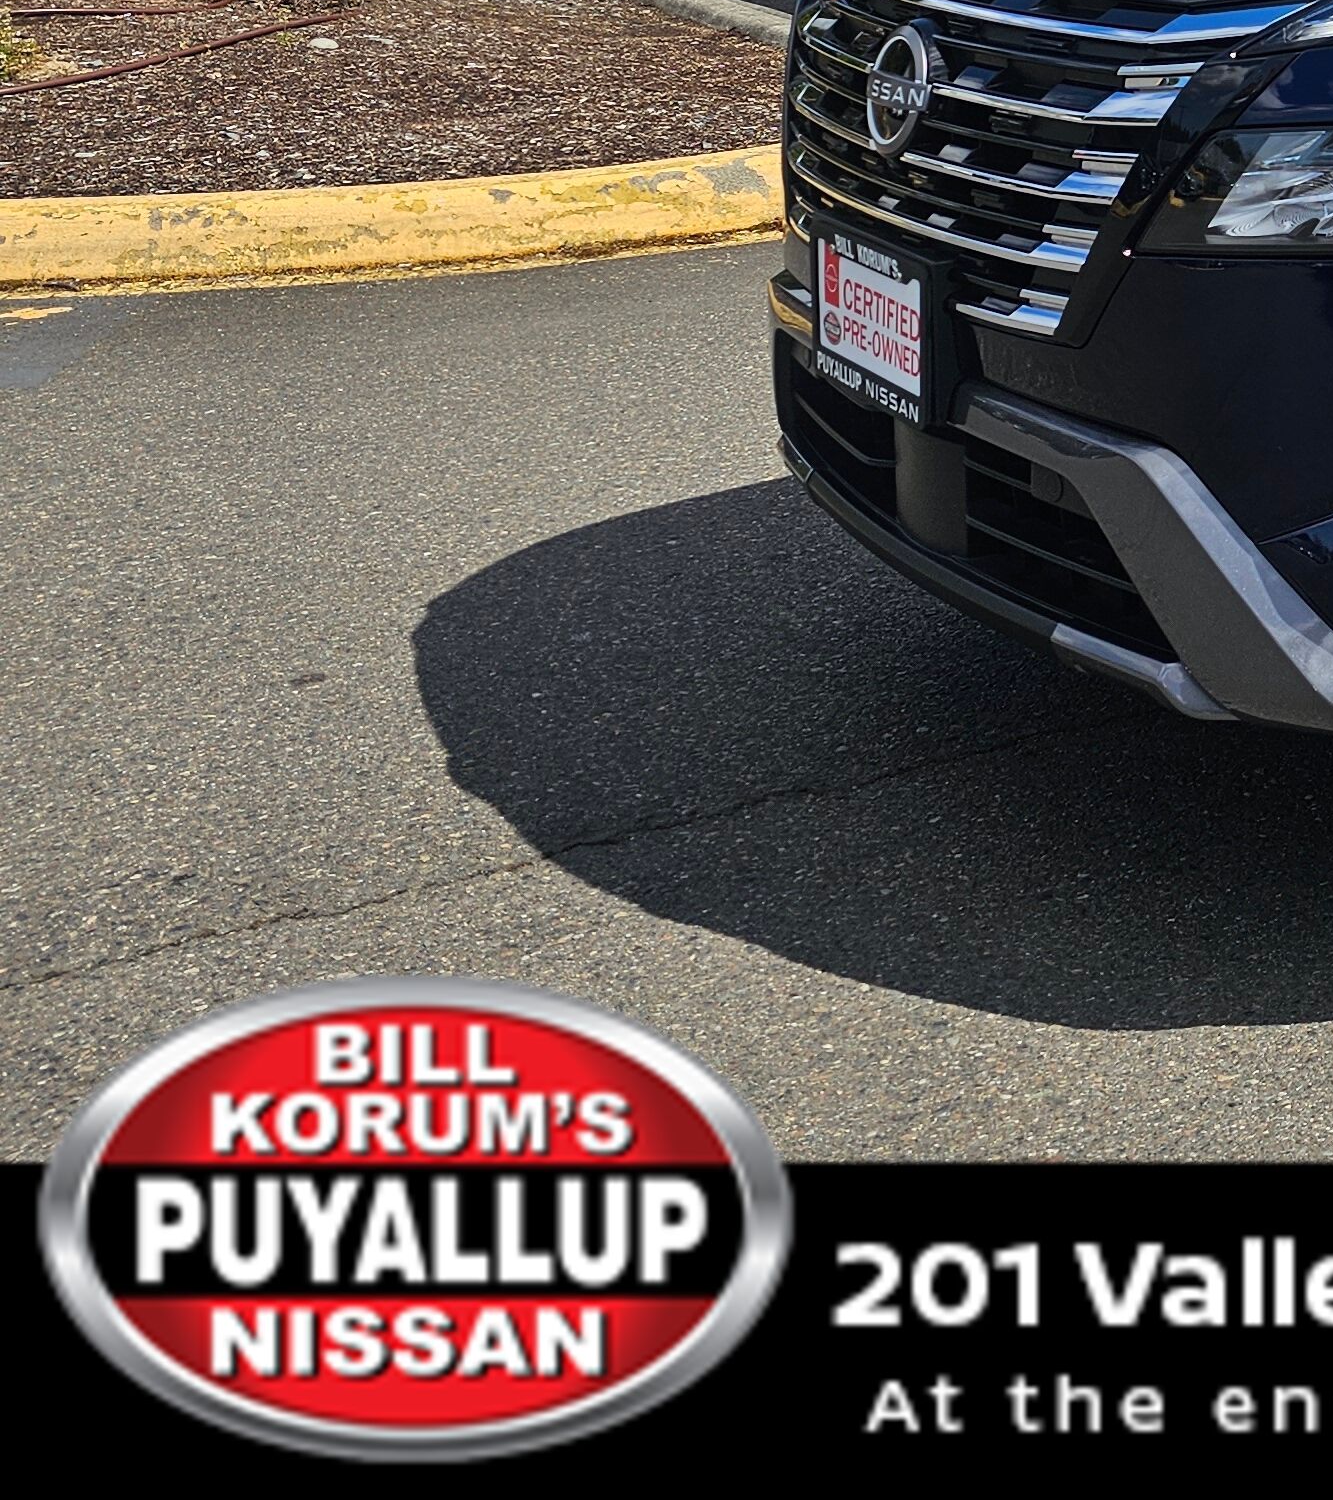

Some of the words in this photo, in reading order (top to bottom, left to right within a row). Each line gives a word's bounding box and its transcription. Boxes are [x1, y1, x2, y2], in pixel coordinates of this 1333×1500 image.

[834, 233, 854, 260] BILL
[856, 243, 899, 278] KORUM'S
[842, 278, 920, 342] CERTIFIED
[842, 315, 920, 377] PRE-OWNED
[816, 350, 863, 391] PUYALLUP
[865, 378, 919, 423] NISSAN
